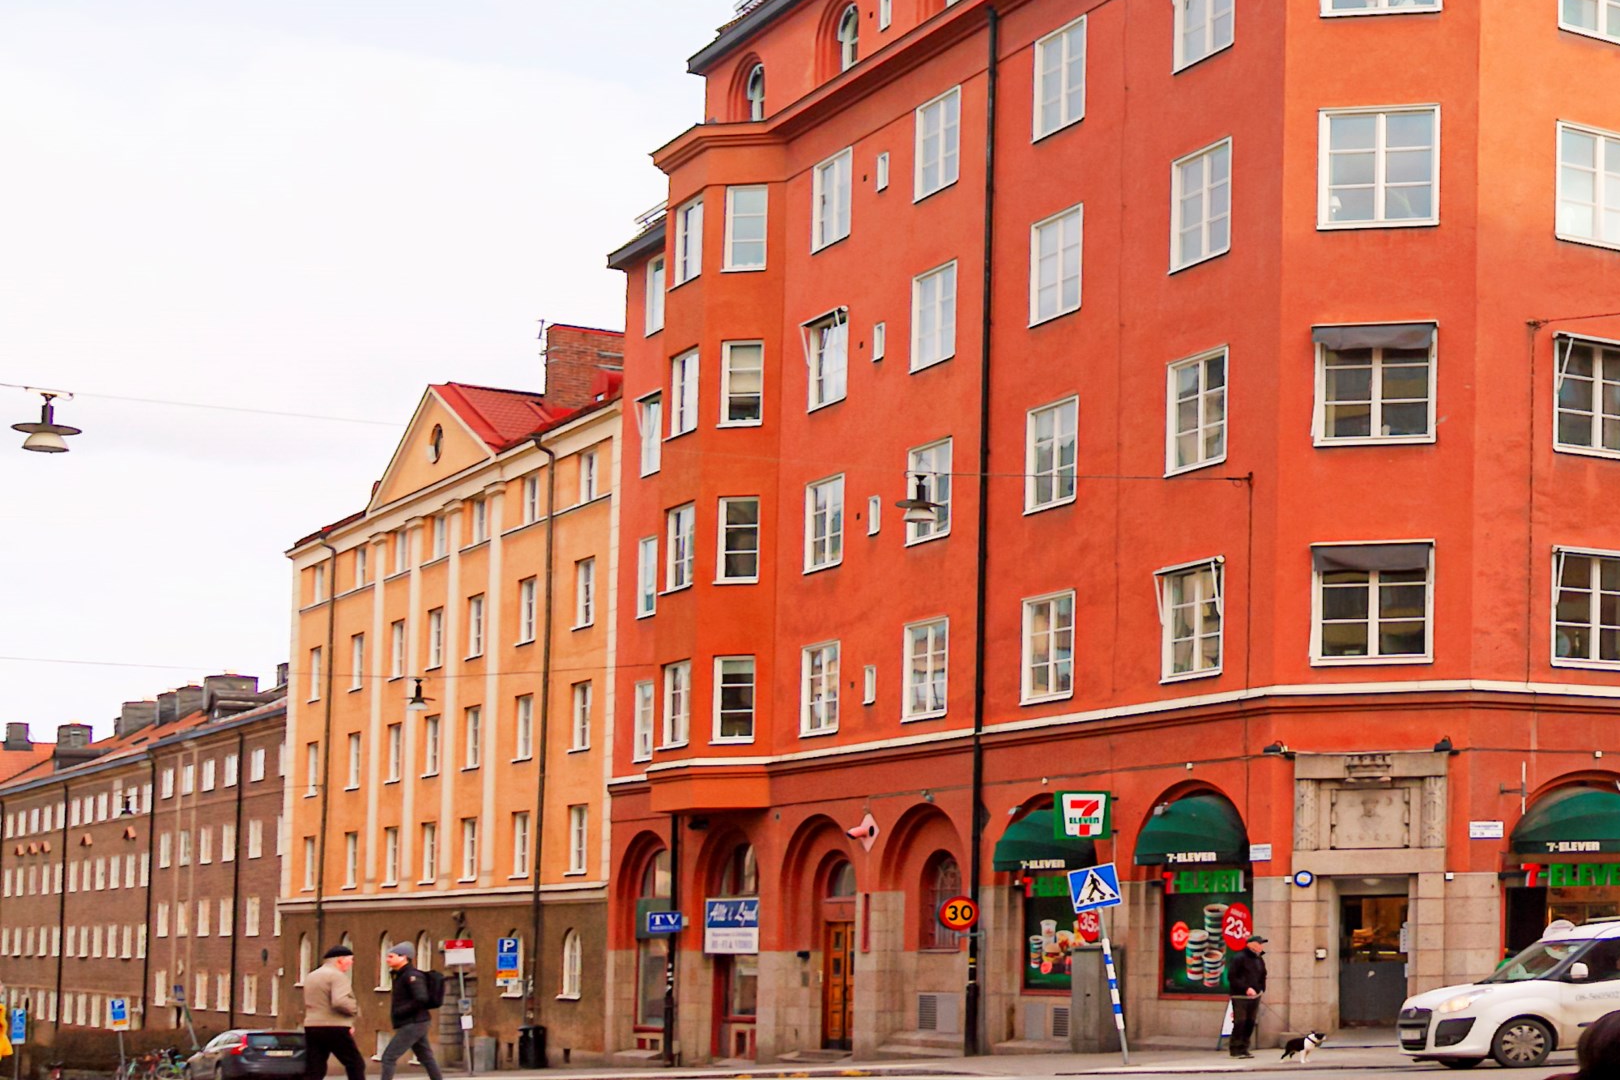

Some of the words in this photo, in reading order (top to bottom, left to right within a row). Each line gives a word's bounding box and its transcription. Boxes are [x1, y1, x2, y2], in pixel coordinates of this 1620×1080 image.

[651, 914, 680, 926] TV
[948, 905, 973, 921] 30
[503, 939, 516, 953] P
